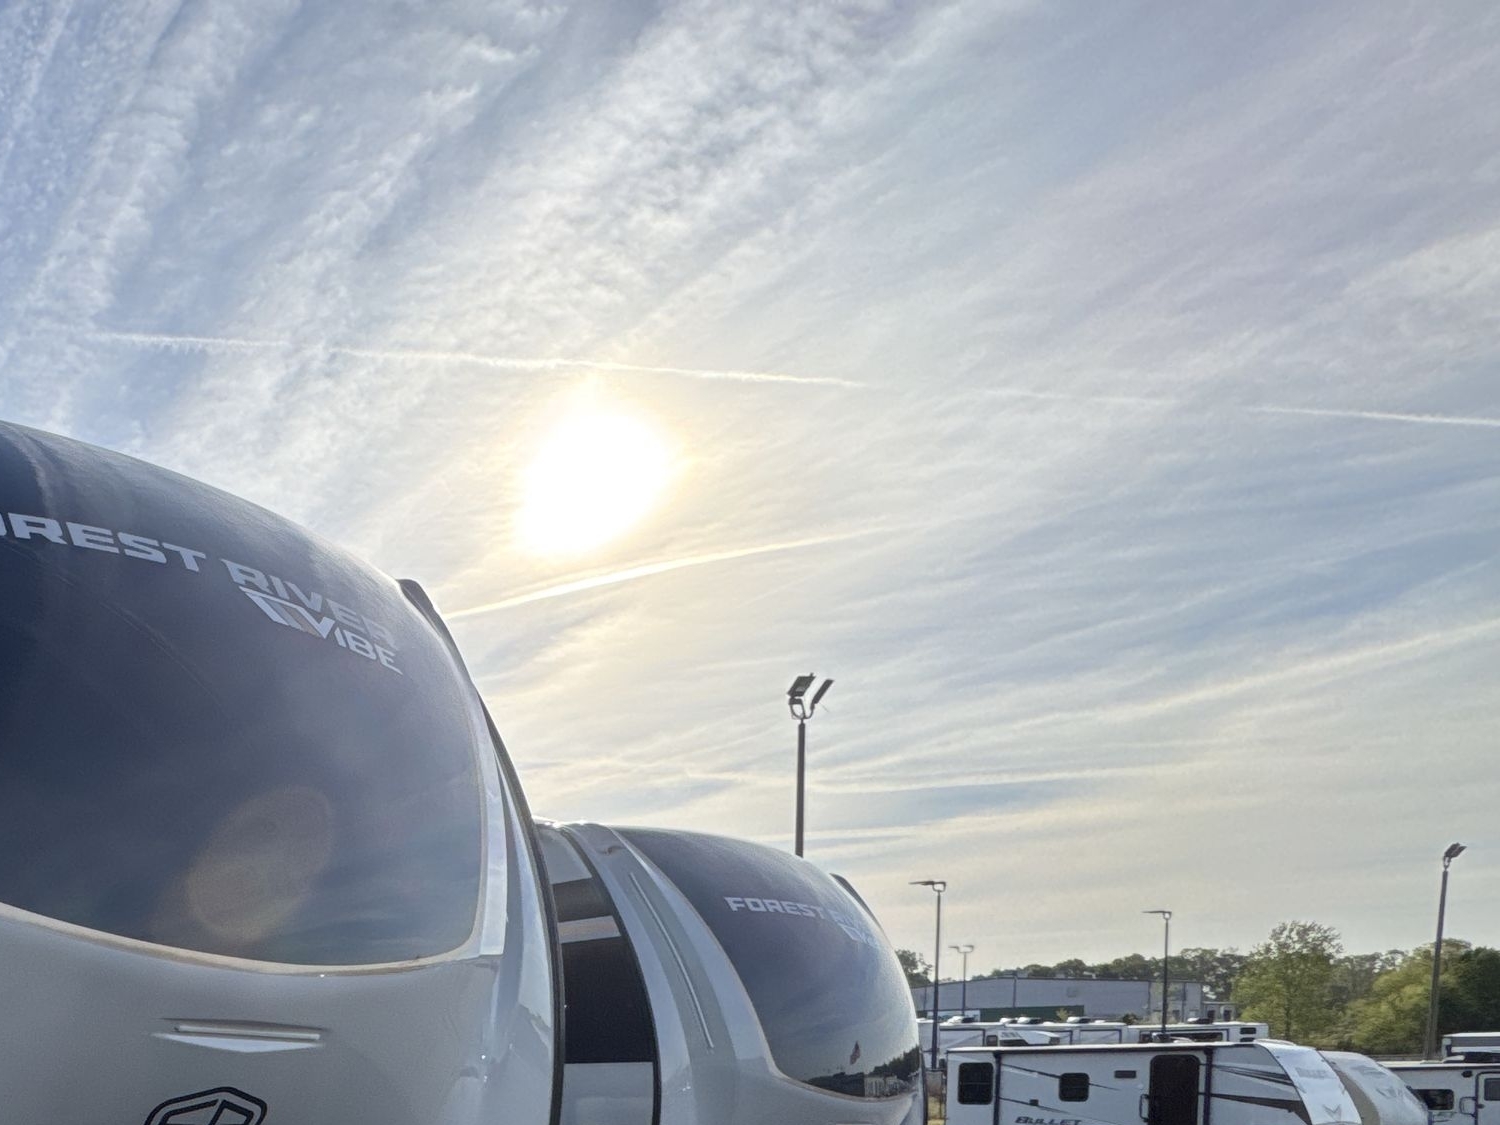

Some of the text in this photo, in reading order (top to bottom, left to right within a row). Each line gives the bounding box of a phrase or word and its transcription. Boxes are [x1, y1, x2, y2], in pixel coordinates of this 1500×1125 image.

[220, 558, 398, 650] RIVER
[238, 586, 404, 676] VIBE
[724, 896, 824, 920] FOREST
[1015, 1116, 1081, 1125] BULLET
